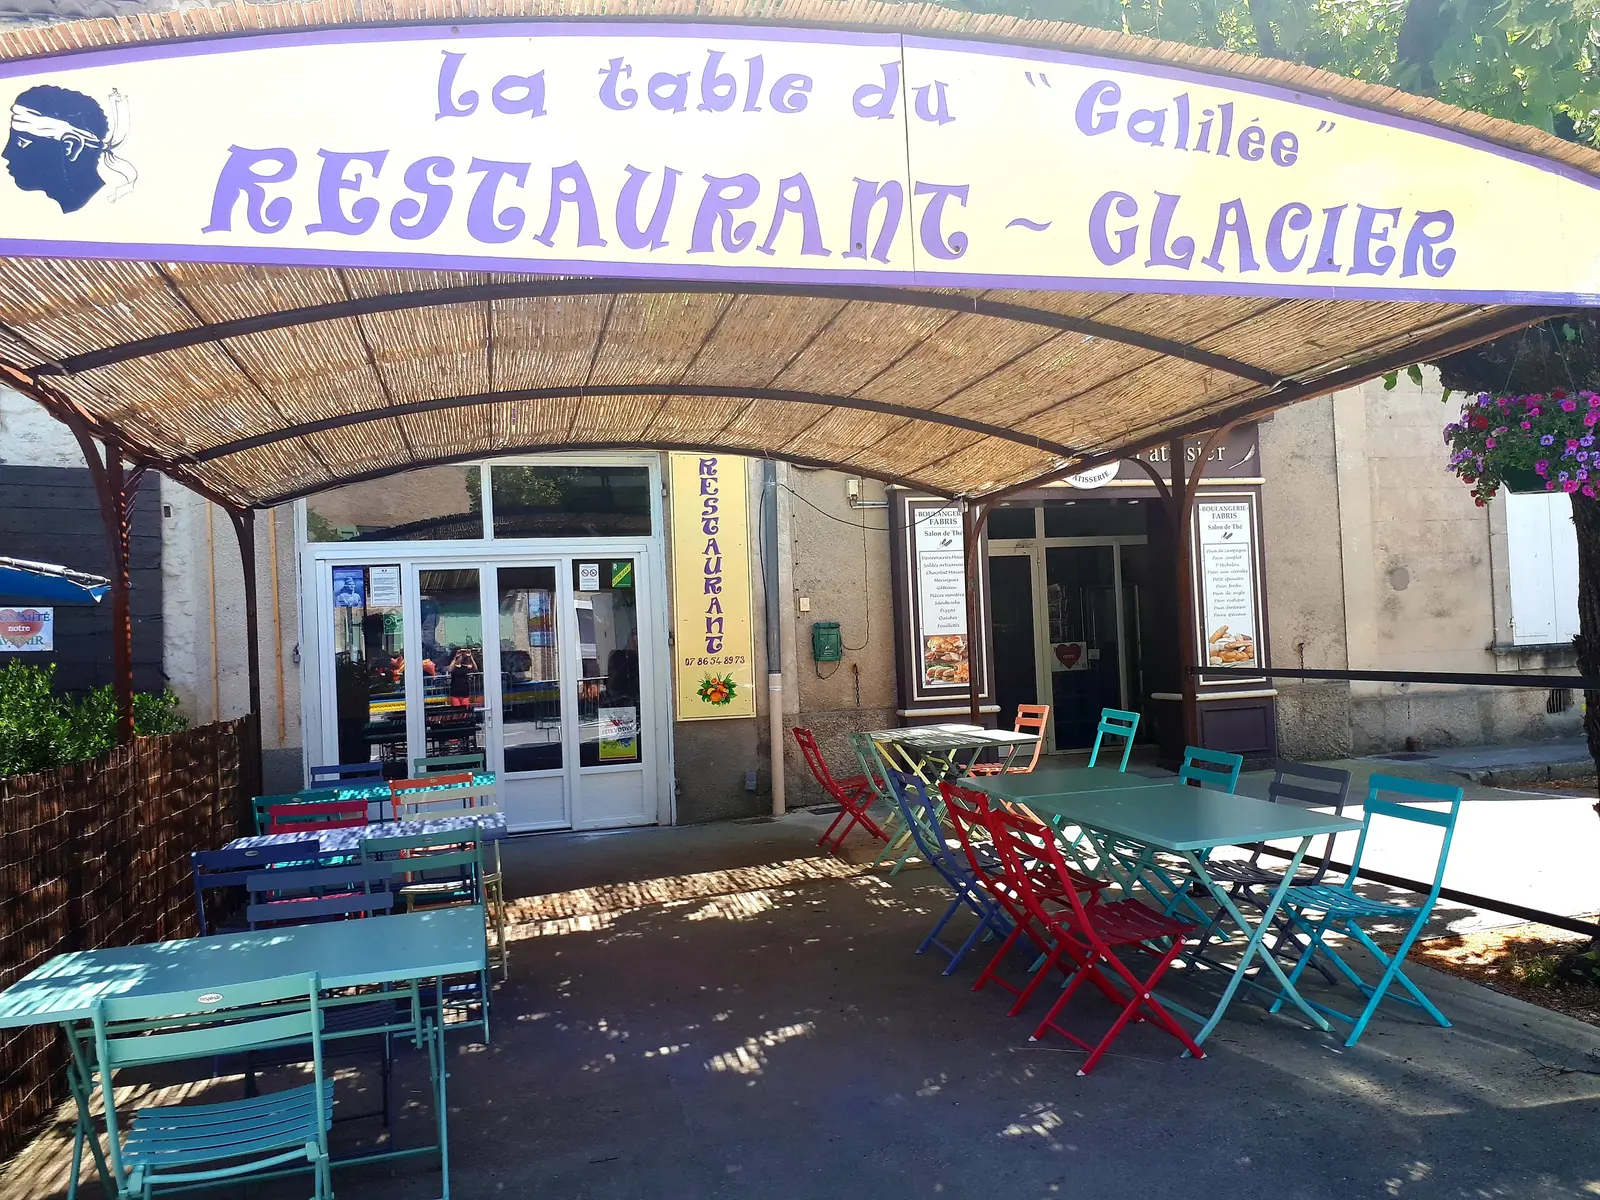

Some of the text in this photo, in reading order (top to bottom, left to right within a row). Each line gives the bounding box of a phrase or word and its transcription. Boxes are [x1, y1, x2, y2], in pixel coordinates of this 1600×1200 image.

[435, 50, 547, 121] La
[599, 52, 814, 115] table
[853, 62, 955, 125] du
[201, 144, 969, 261] RESTAURANT
[1088, 190, 1456, 278] GLACIER
[1071, 470, 1111, 484] ATISSERIE
[929, 518, 958, 526] FABRIS
[1212, 512, 1238, 520] FABRIS
[699, 457, 724, 654] RESTAURANT
[685, 655, 746, 667] 07 86 54 89 73
